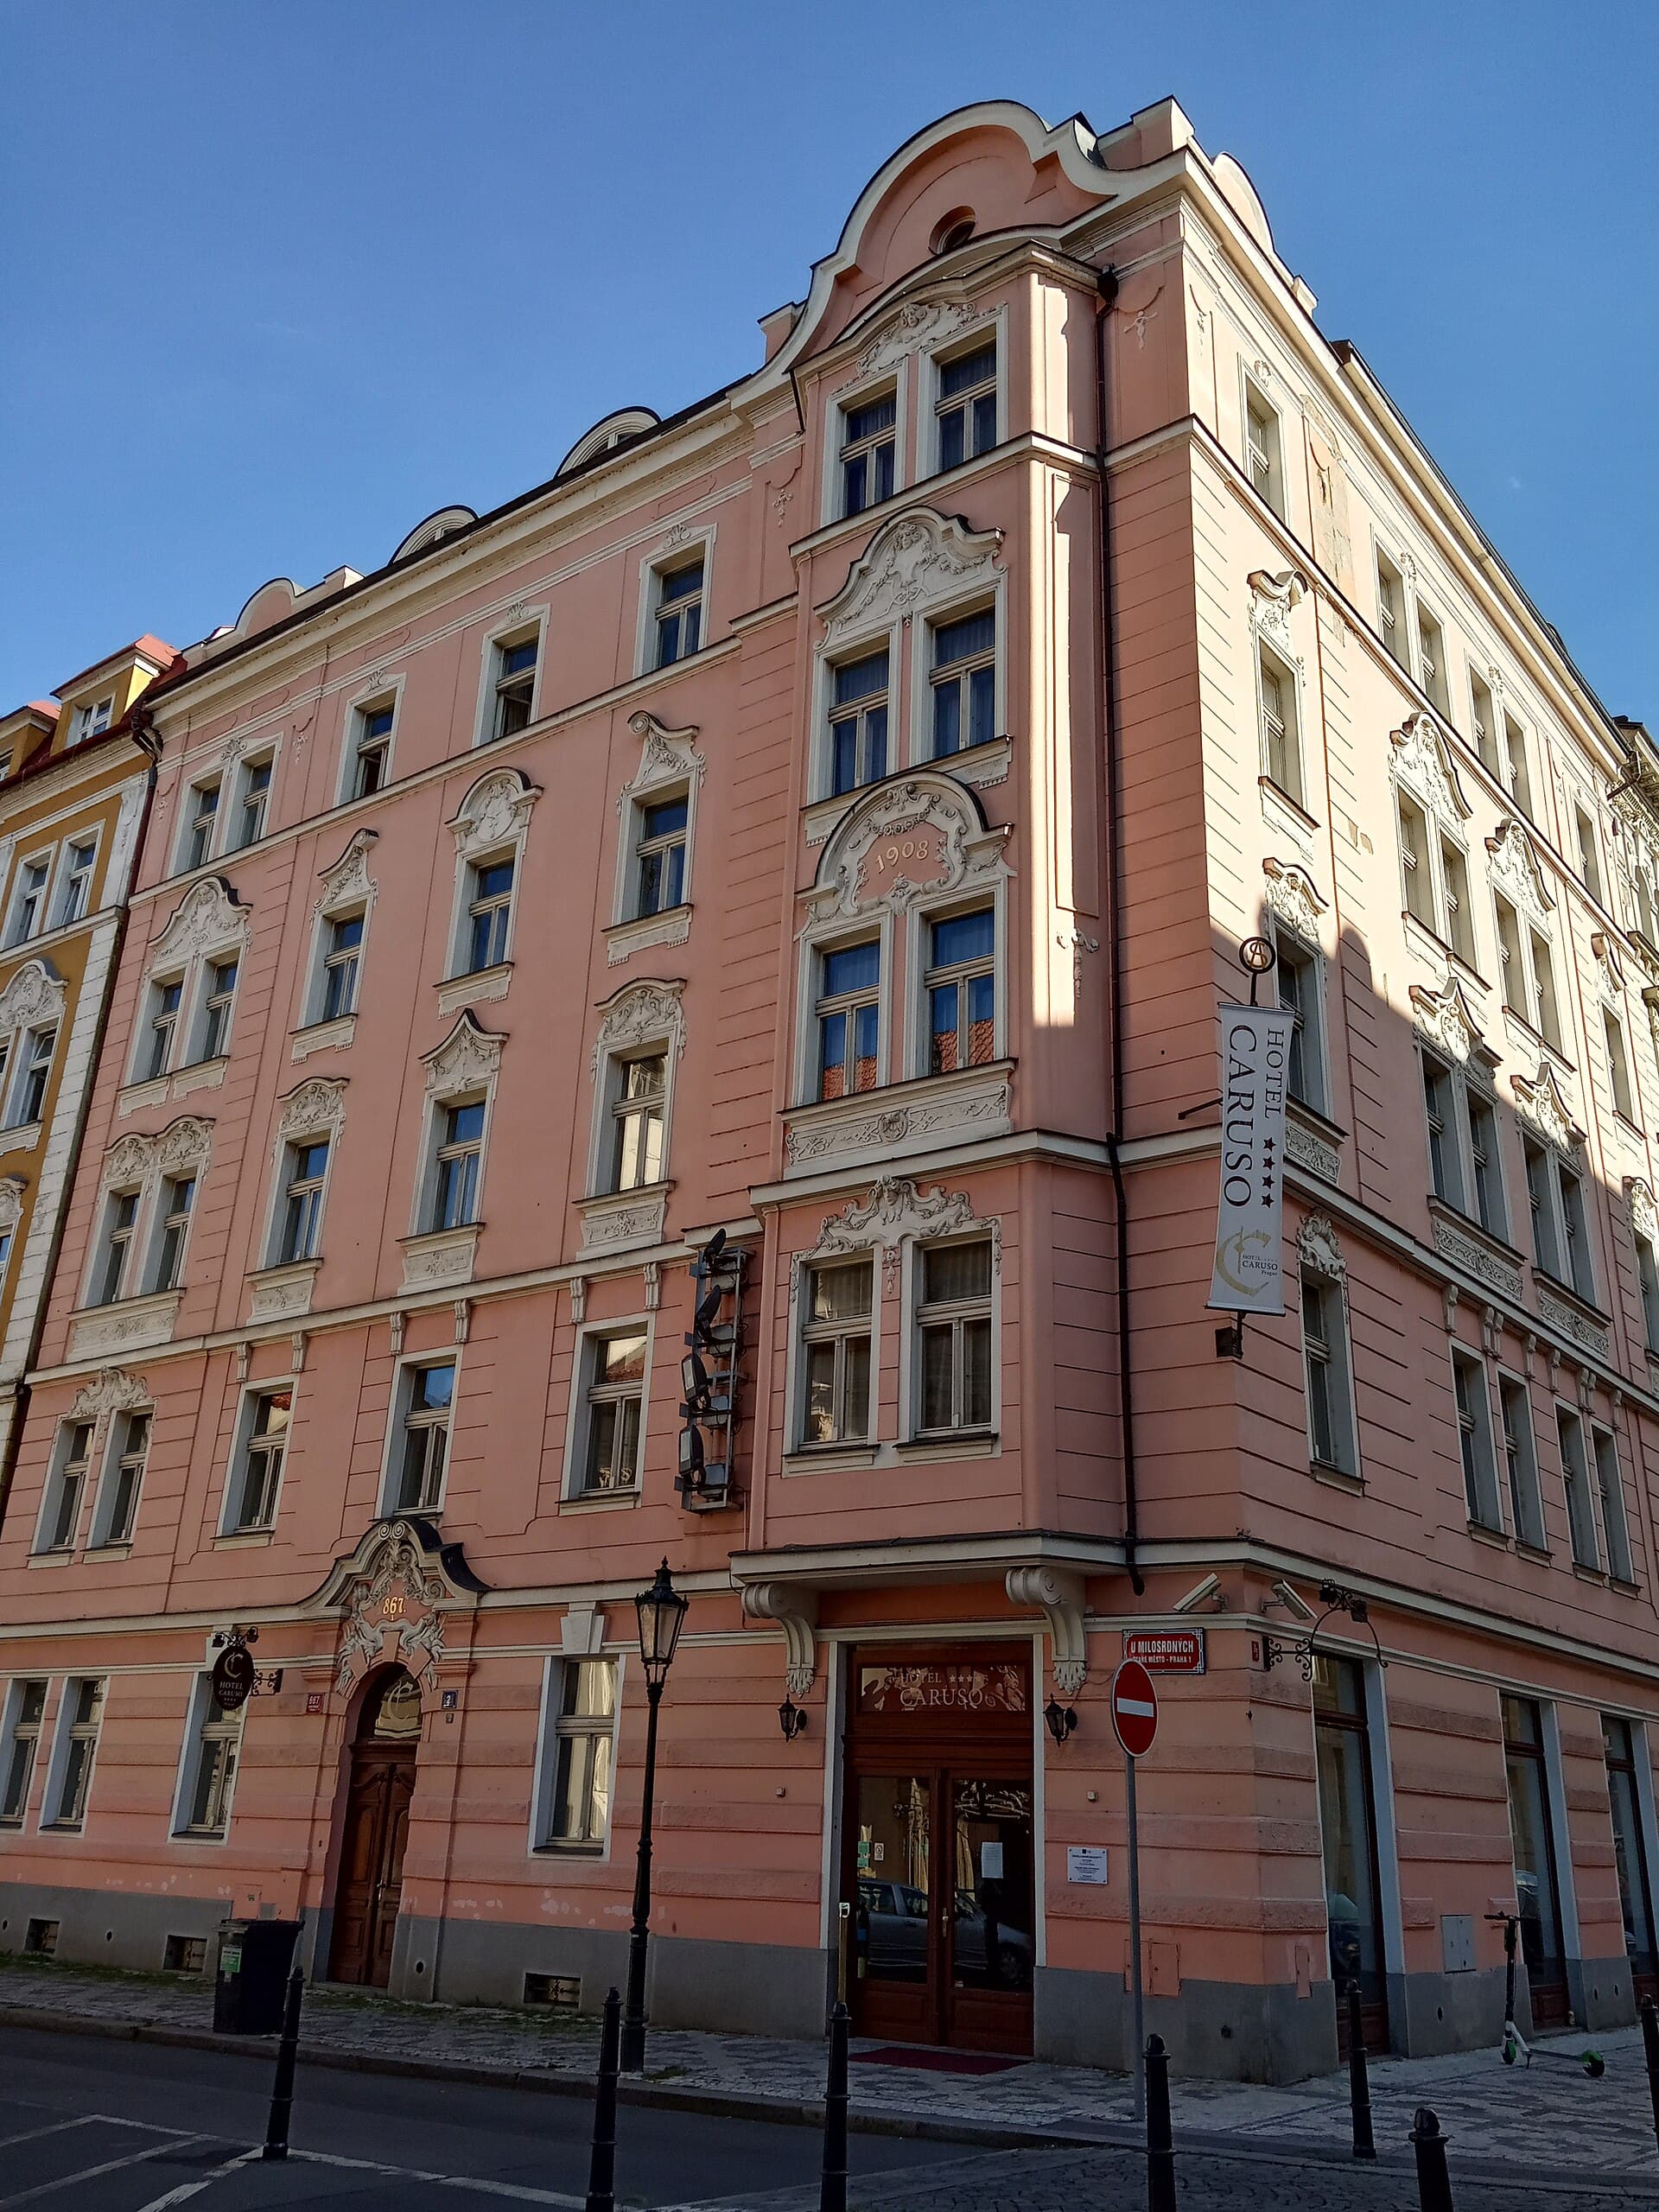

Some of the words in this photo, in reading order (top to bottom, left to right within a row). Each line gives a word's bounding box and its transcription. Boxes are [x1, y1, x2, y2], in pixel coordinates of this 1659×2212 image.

[874, 840, 929, 874] 1908
[1264, 1028, 1284, 1119] HOTEL
[1224, 1025, 1257, 1207] CARUSO
[1242, 1260, 1278, 1271] CARUSO
[1130, 1641, 1136, 1654] U
[1137, 1637, 1194, 1654] MILOSRDNÝCH
[1147, 1654, 1166, 1663] MĚSTO
[1169, 1655, 1187, 1663] PRAHA
[219, 1681, 243, 1690] HOTEL
[900, 1671, 942, 1684] HOTEL
[899, 1688, 984, 1706] CARUSO
